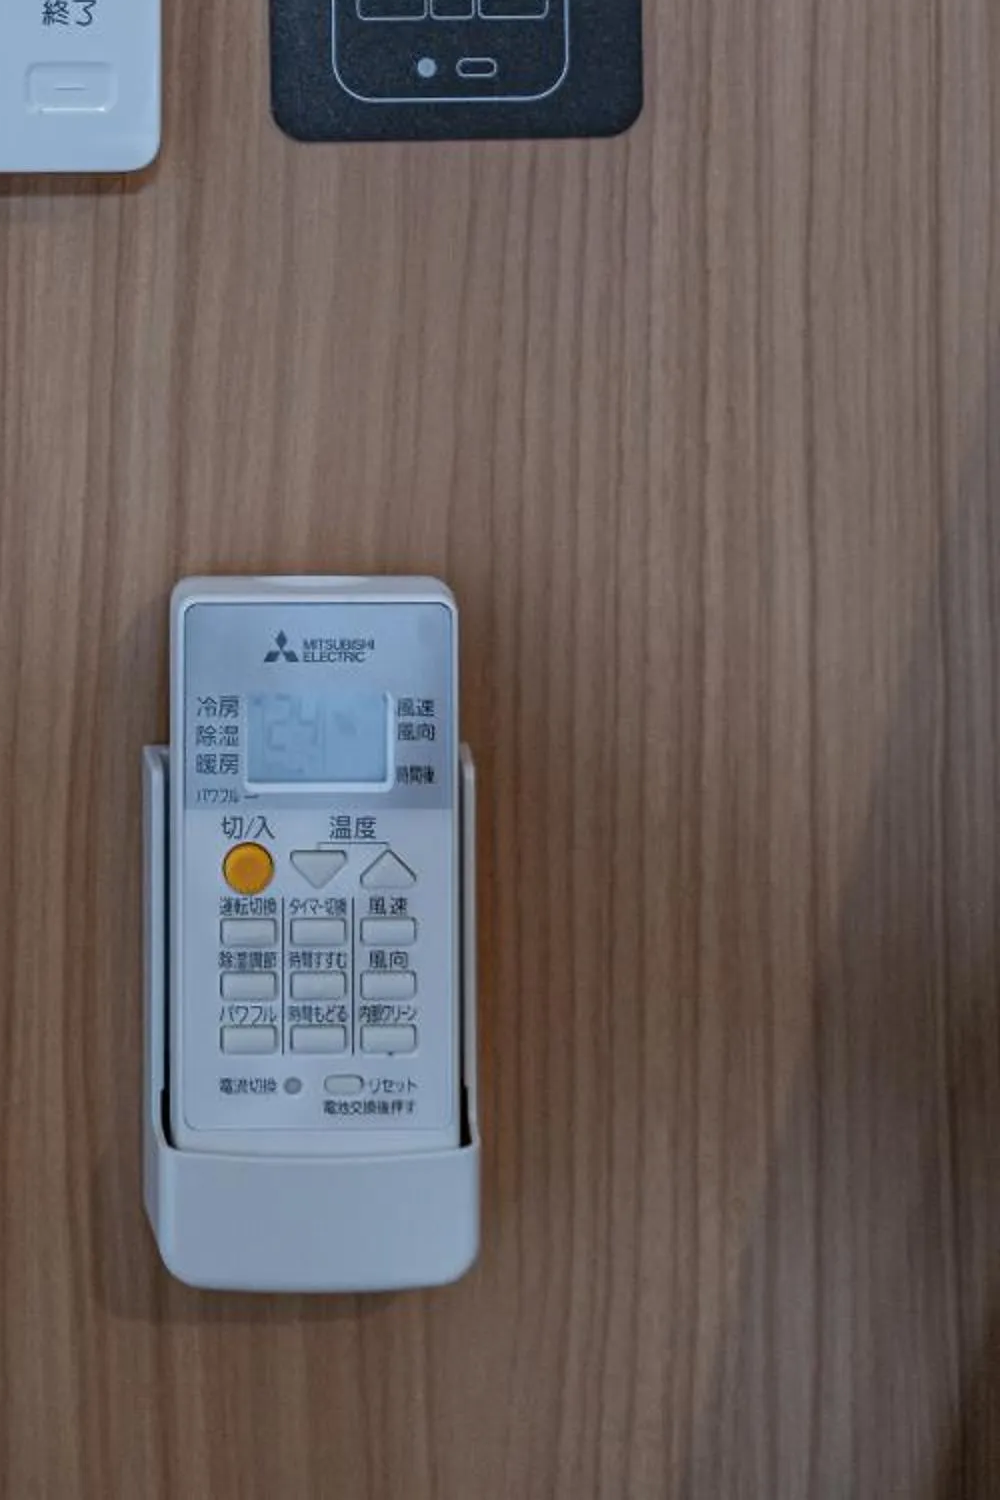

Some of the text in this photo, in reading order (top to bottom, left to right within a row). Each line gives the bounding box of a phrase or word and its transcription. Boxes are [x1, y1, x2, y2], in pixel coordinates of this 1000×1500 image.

[302, 638, 375, 651] MITSUBISHI
[302, 651, 367, 663] ELECTRIC
[196, 695, 239, 718] 冷房
[397, 698, 435, 717] 風速
[195, 725, 239, 747] 除湿
[397, 722, 435, 741] 風向
[195, 753, 239, 775] 暖房
[220, 815, 275, 840] 切/入
[329, 815, 377, 839] 温度
[219, 897, 278, 915] 運転切換
[369, 897, 409, 915] 風速
[370, 951, 409, 969] 風向
[219, 1005, 277, 1022] パワフル
[359, 1005, 417, 1023] 内部クリーン
[369, 1077, 418, 1094] リセット
